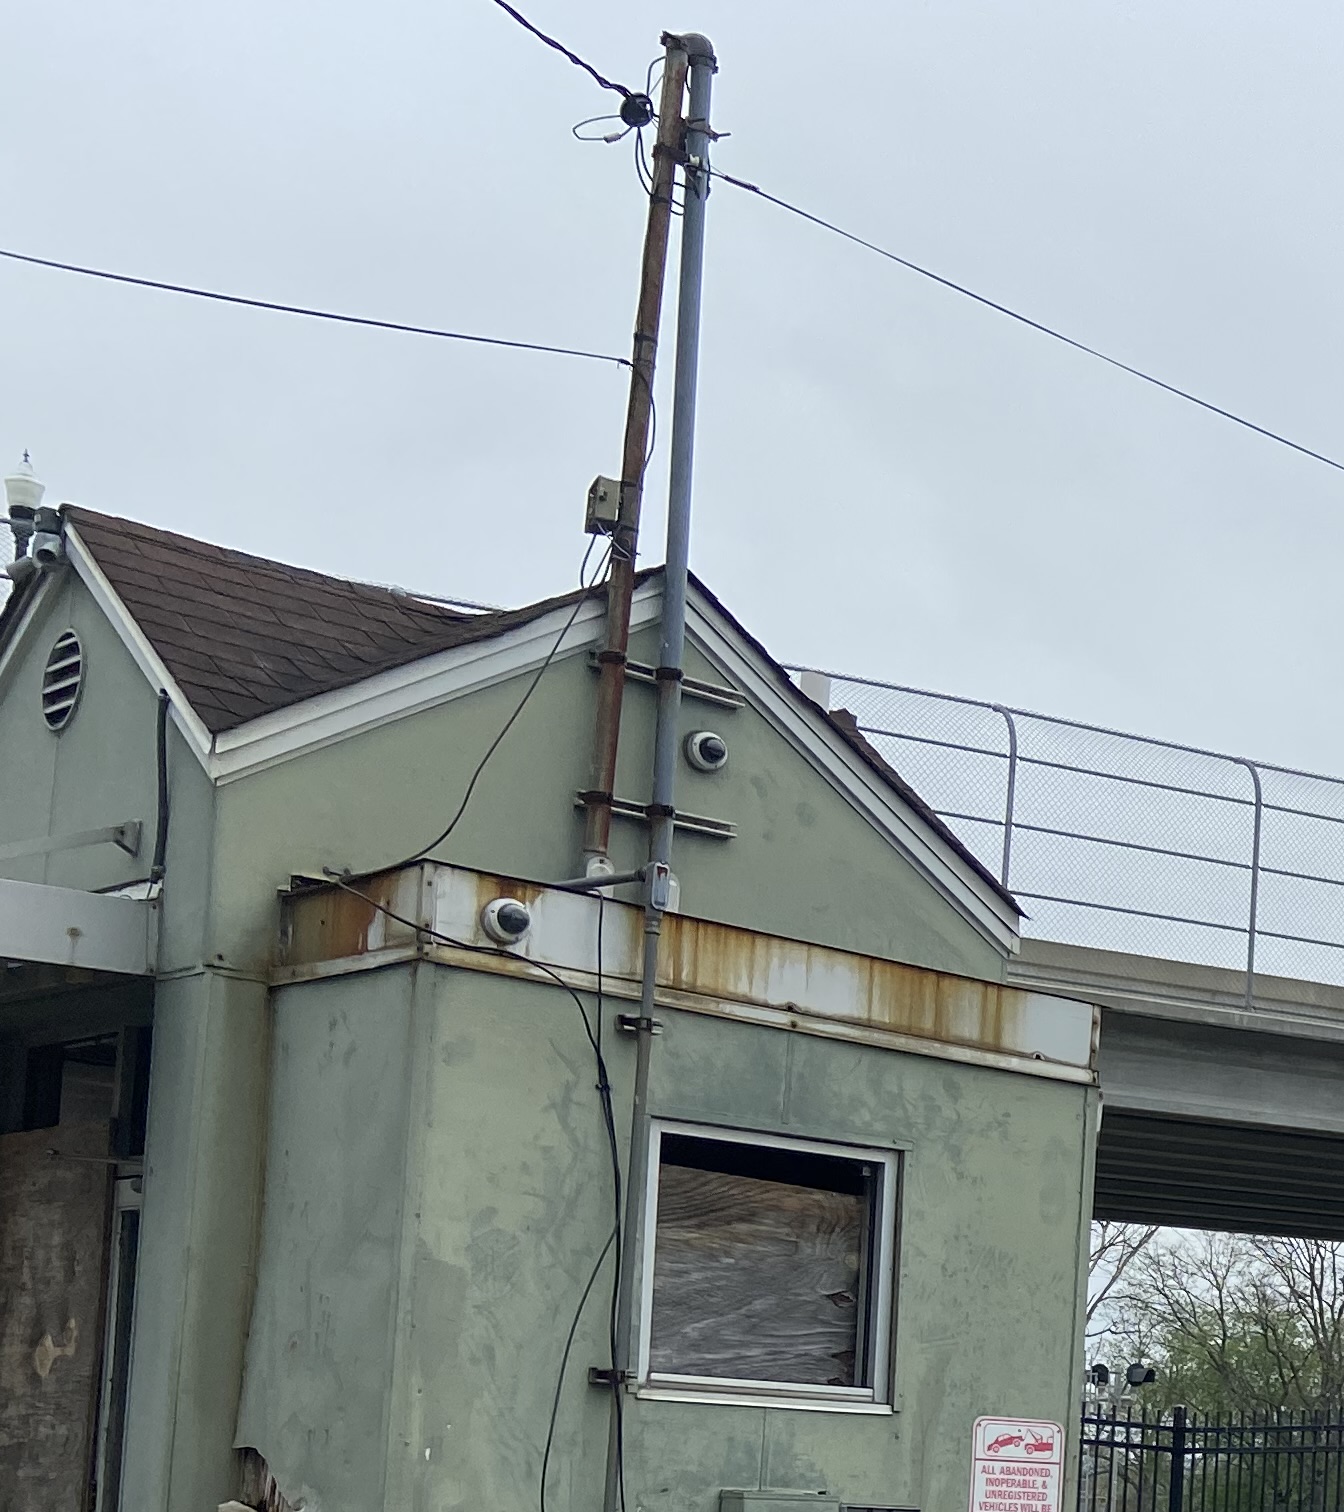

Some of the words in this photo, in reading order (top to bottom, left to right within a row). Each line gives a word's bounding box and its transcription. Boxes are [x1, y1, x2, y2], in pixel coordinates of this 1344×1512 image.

[981, 1465, 996, 1475] ALL
[999, 1466, 1053, 1478] ABANDONED,
[985, 1477, 1039, 1490] INOPERABLE,
[1041, 1480, 1047, 1489] &
[985, 1490, 1047, 1501] UNREGISTERED
[979, 1502, 1018, 1512] VEHICLES
[1020, 1503, 1039, 1512] WILL
[1041, 1504, 1052, 1512] BE
